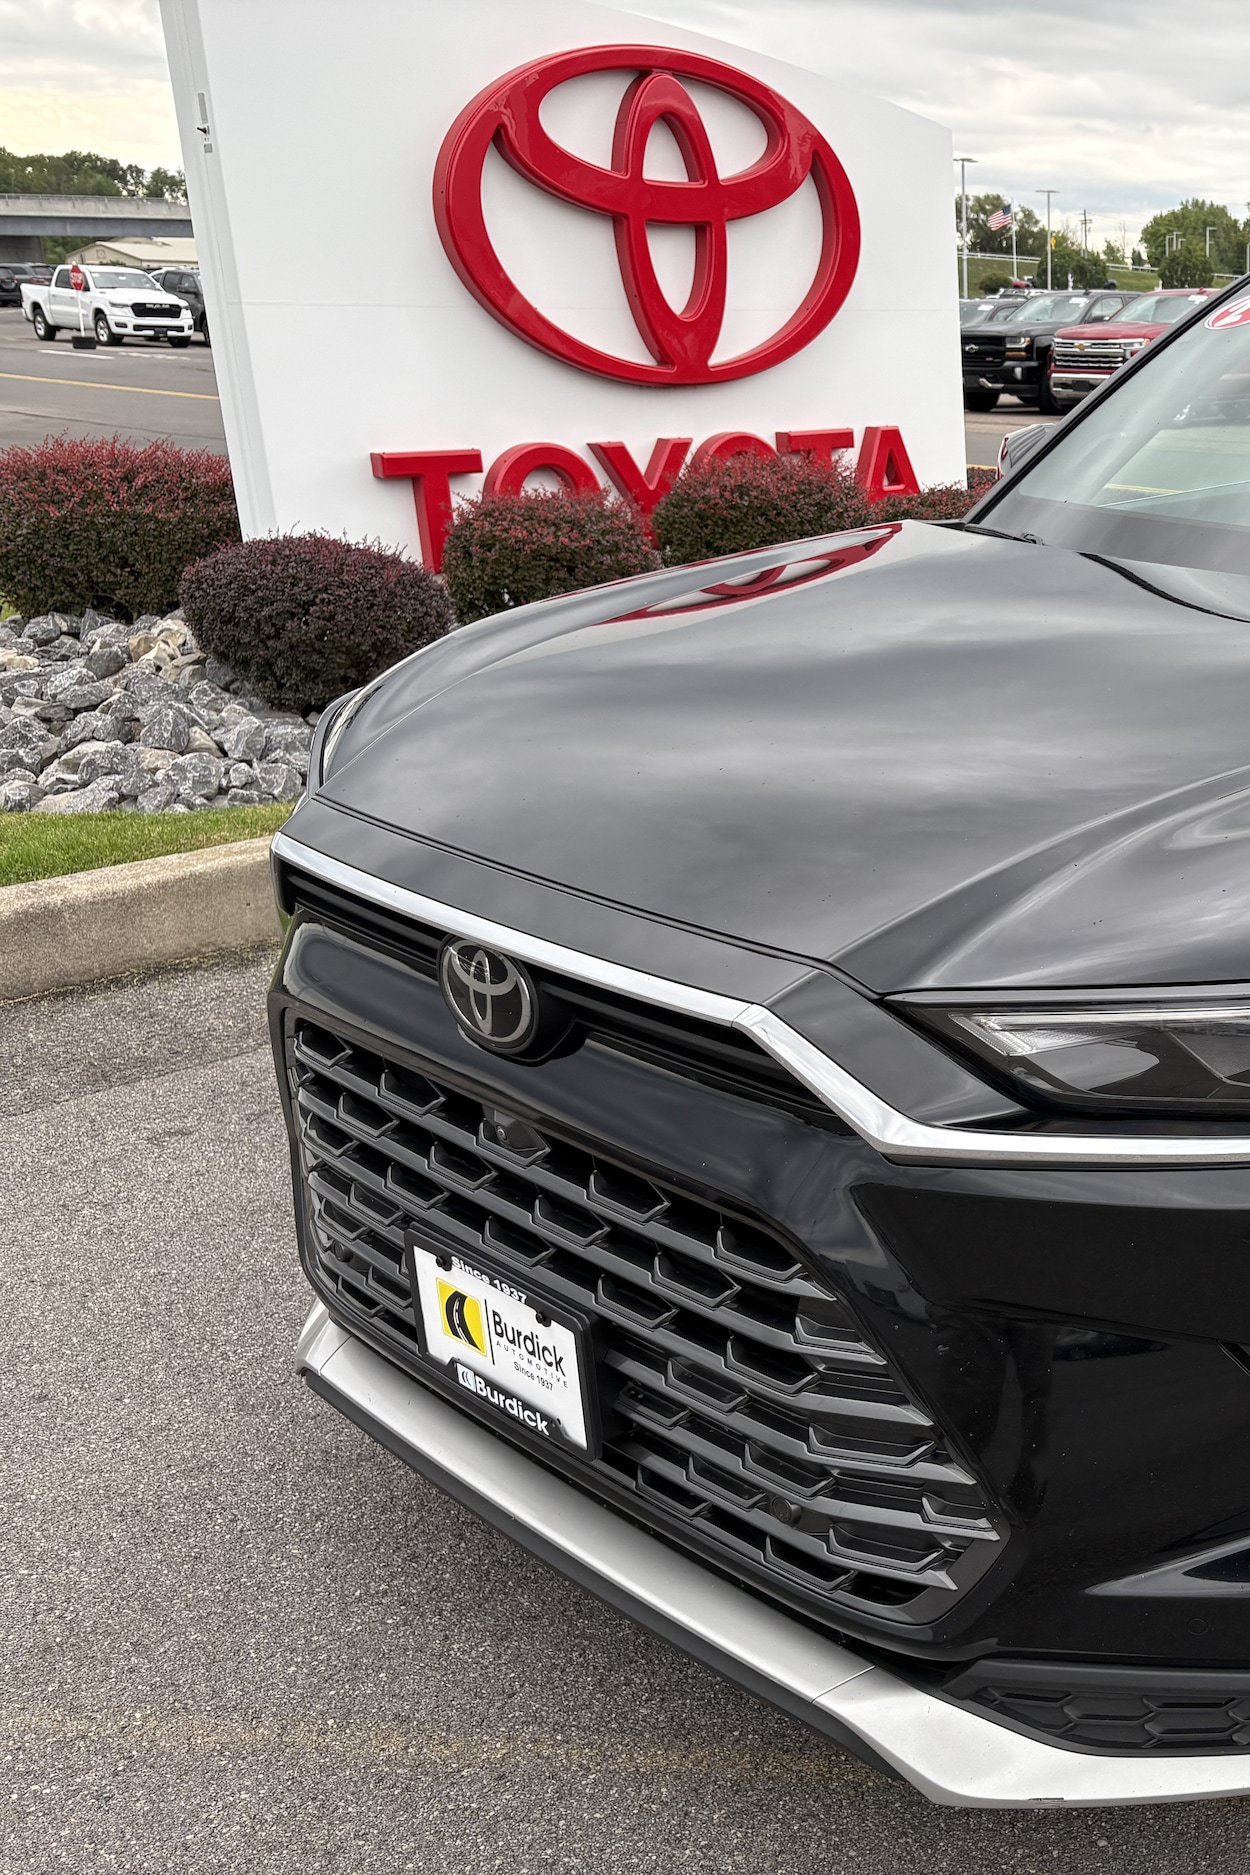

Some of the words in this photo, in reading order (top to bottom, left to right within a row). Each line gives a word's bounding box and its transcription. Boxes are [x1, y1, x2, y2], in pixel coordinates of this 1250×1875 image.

[370, 425, 920, 574] TYTA
[451, 1256, 491, 1285] Since
[494, 1279, 527, 1305] 1937
[492, 1309, 566, 1377] Burdick
[496, 1340, 568, 1388] AUTOMOTIVE
[513, 1361, 535, 1381] Since
[536, 1374, 554, 1391] 1937
[475, 1375, 550, 1436] Burdick
